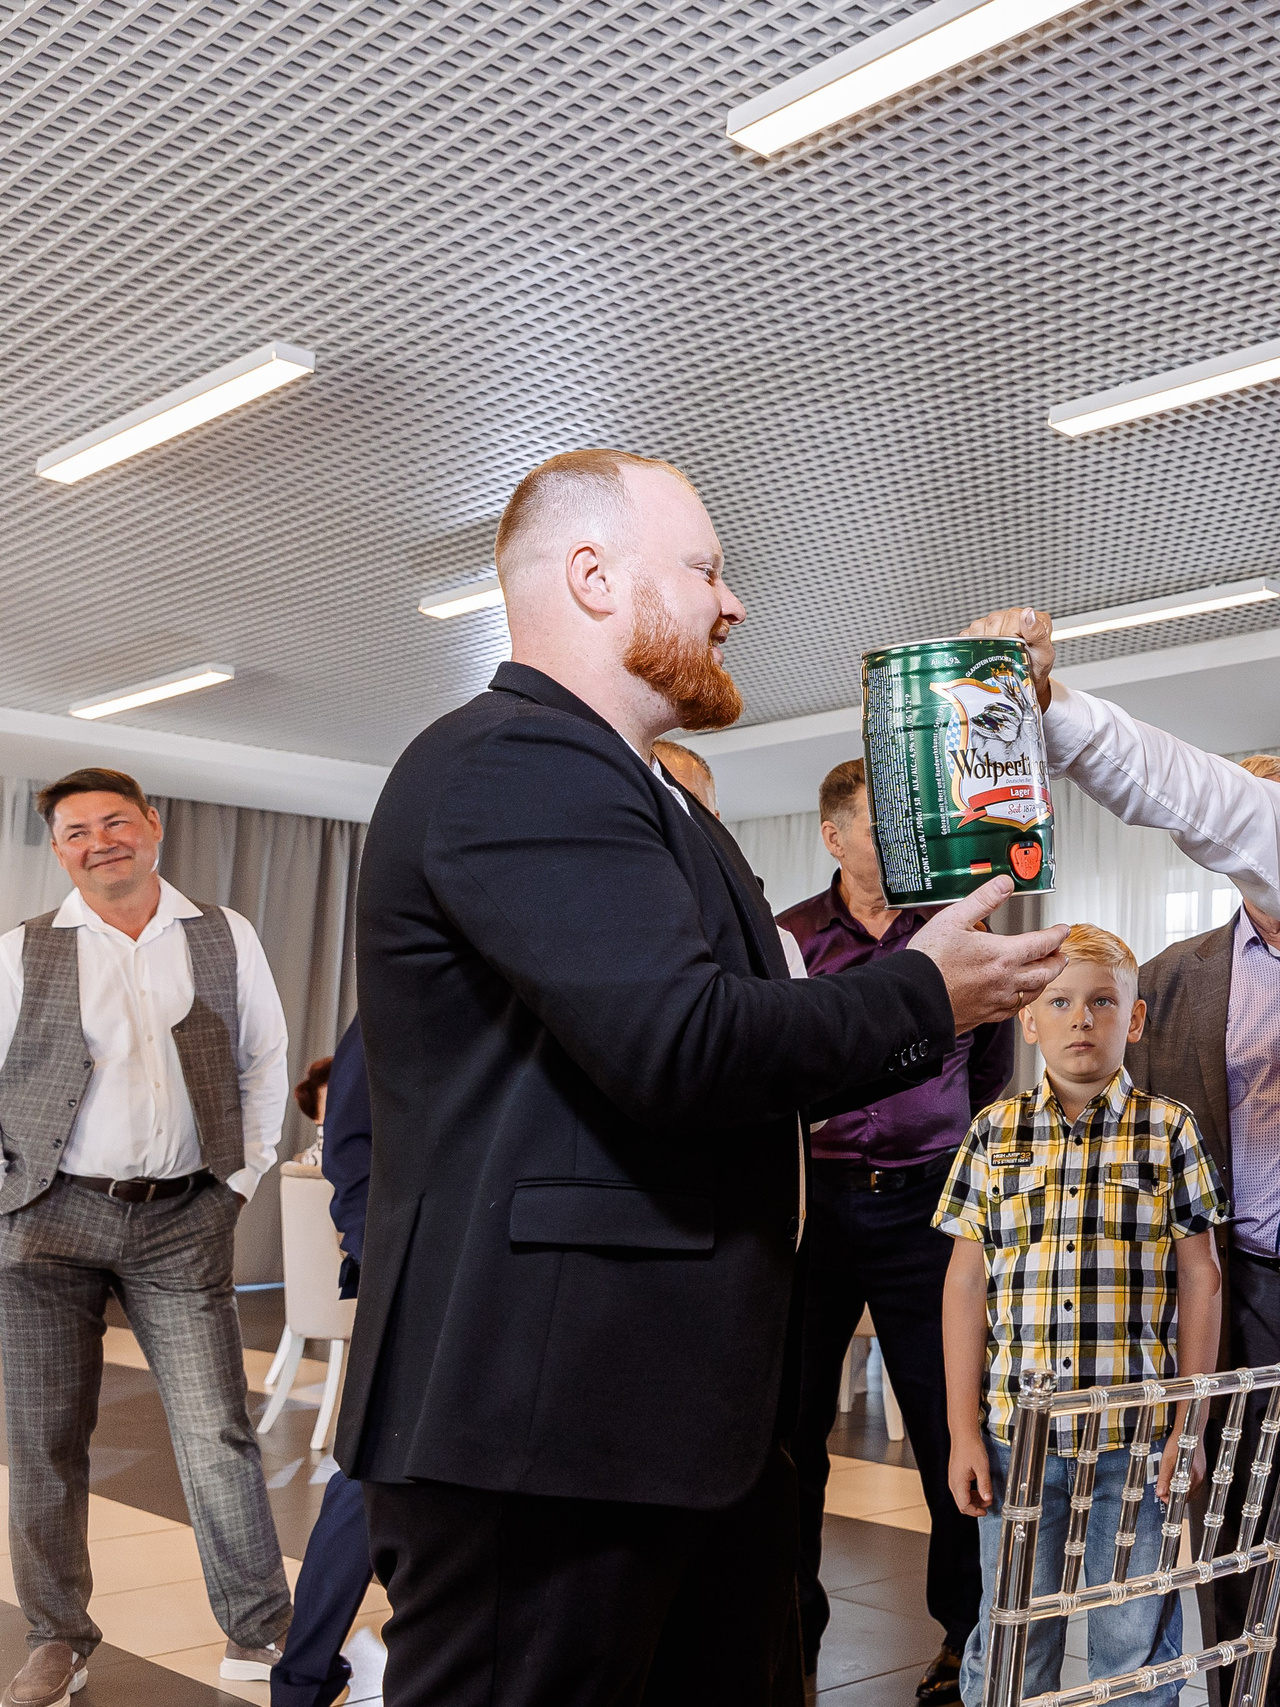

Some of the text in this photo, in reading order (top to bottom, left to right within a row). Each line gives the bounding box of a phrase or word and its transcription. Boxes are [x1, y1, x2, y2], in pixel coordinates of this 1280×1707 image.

[1010, 788, 1031, 798] Lager
[1008, 803, 1022, 815] Seit
[922, 854, 930, 874] CONT.
